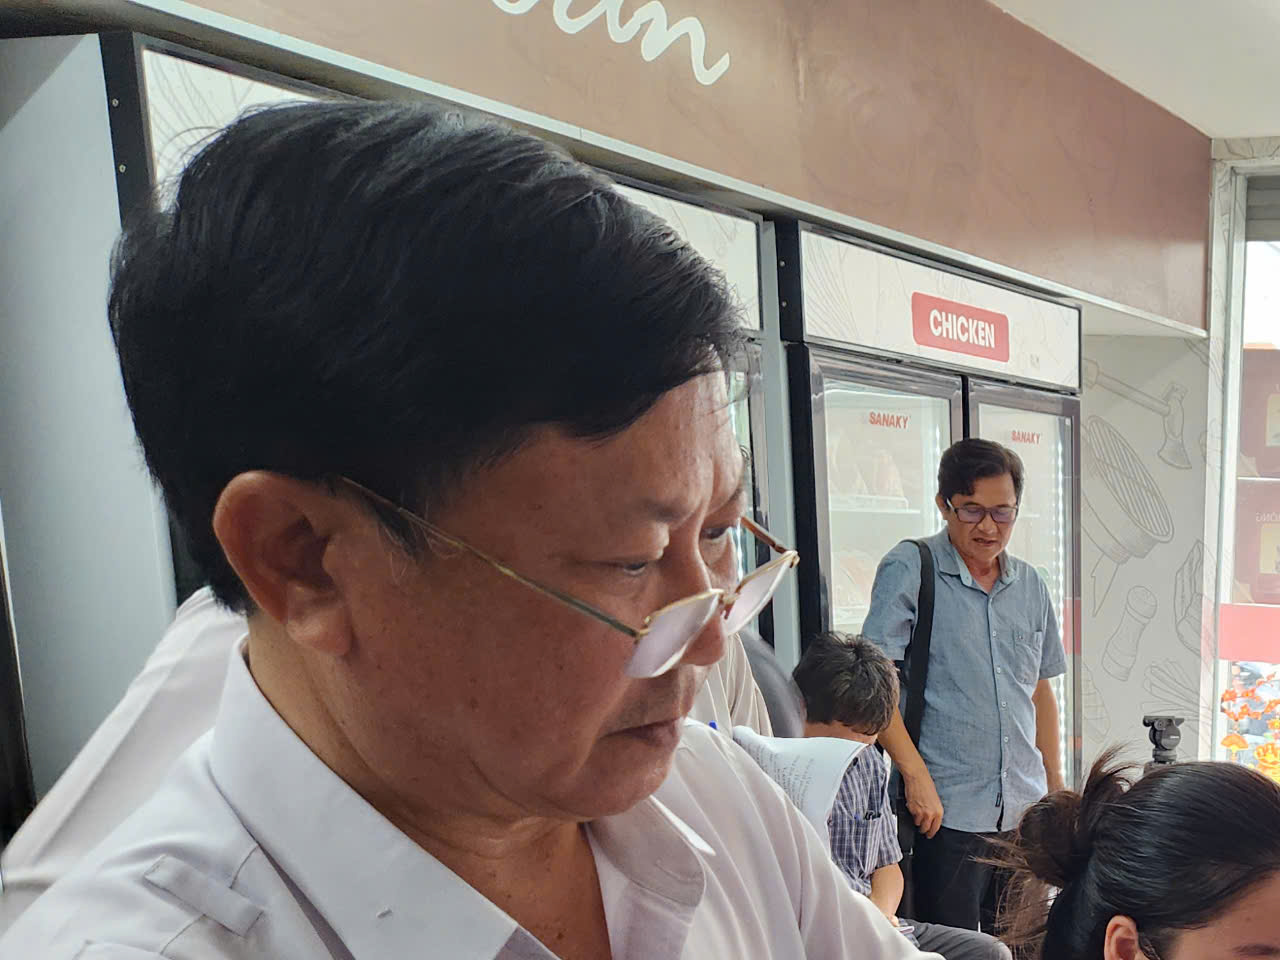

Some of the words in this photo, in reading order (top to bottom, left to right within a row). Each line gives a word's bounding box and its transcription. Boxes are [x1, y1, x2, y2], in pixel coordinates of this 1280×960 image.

[929, 309, 996, 349] CHICKEN
[869, 411, 909, 430] SANAKY
[1011, 430, 1041, 444] SANAKY
